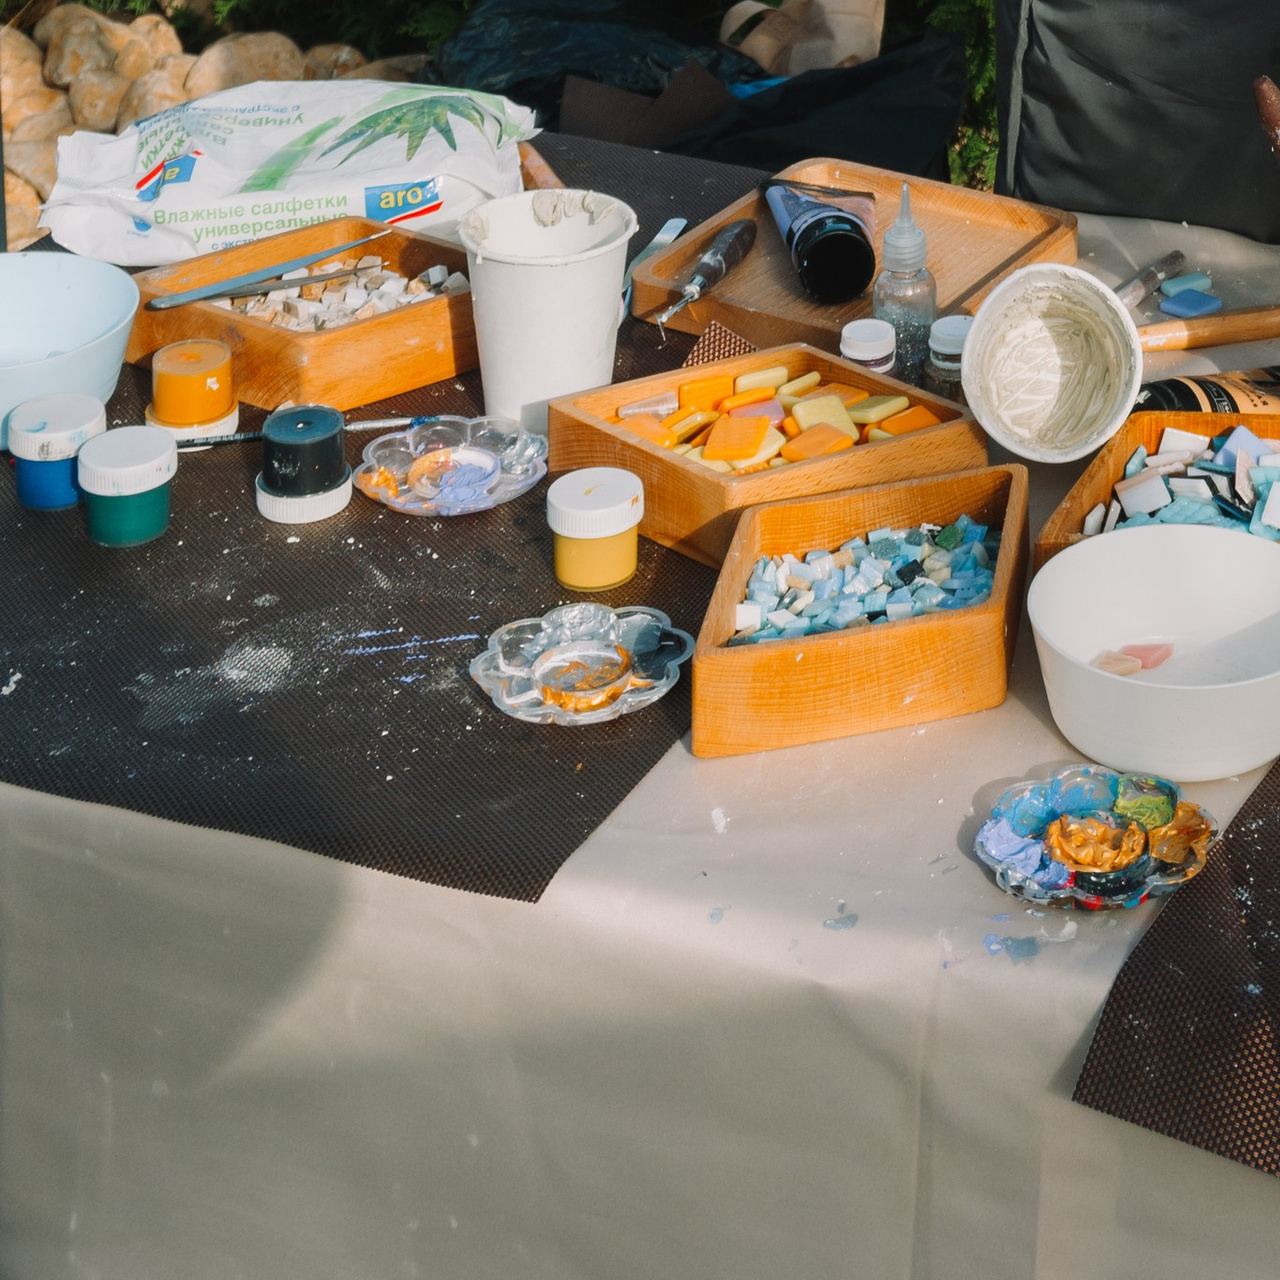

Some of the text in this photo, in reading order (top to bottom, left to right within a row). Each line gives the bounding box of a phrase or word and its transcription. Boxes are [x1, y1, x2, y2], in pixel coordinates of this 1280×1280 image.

[154, 195, 348, 224] Влажные салфетки
[380, 187, 423, 208] aro
